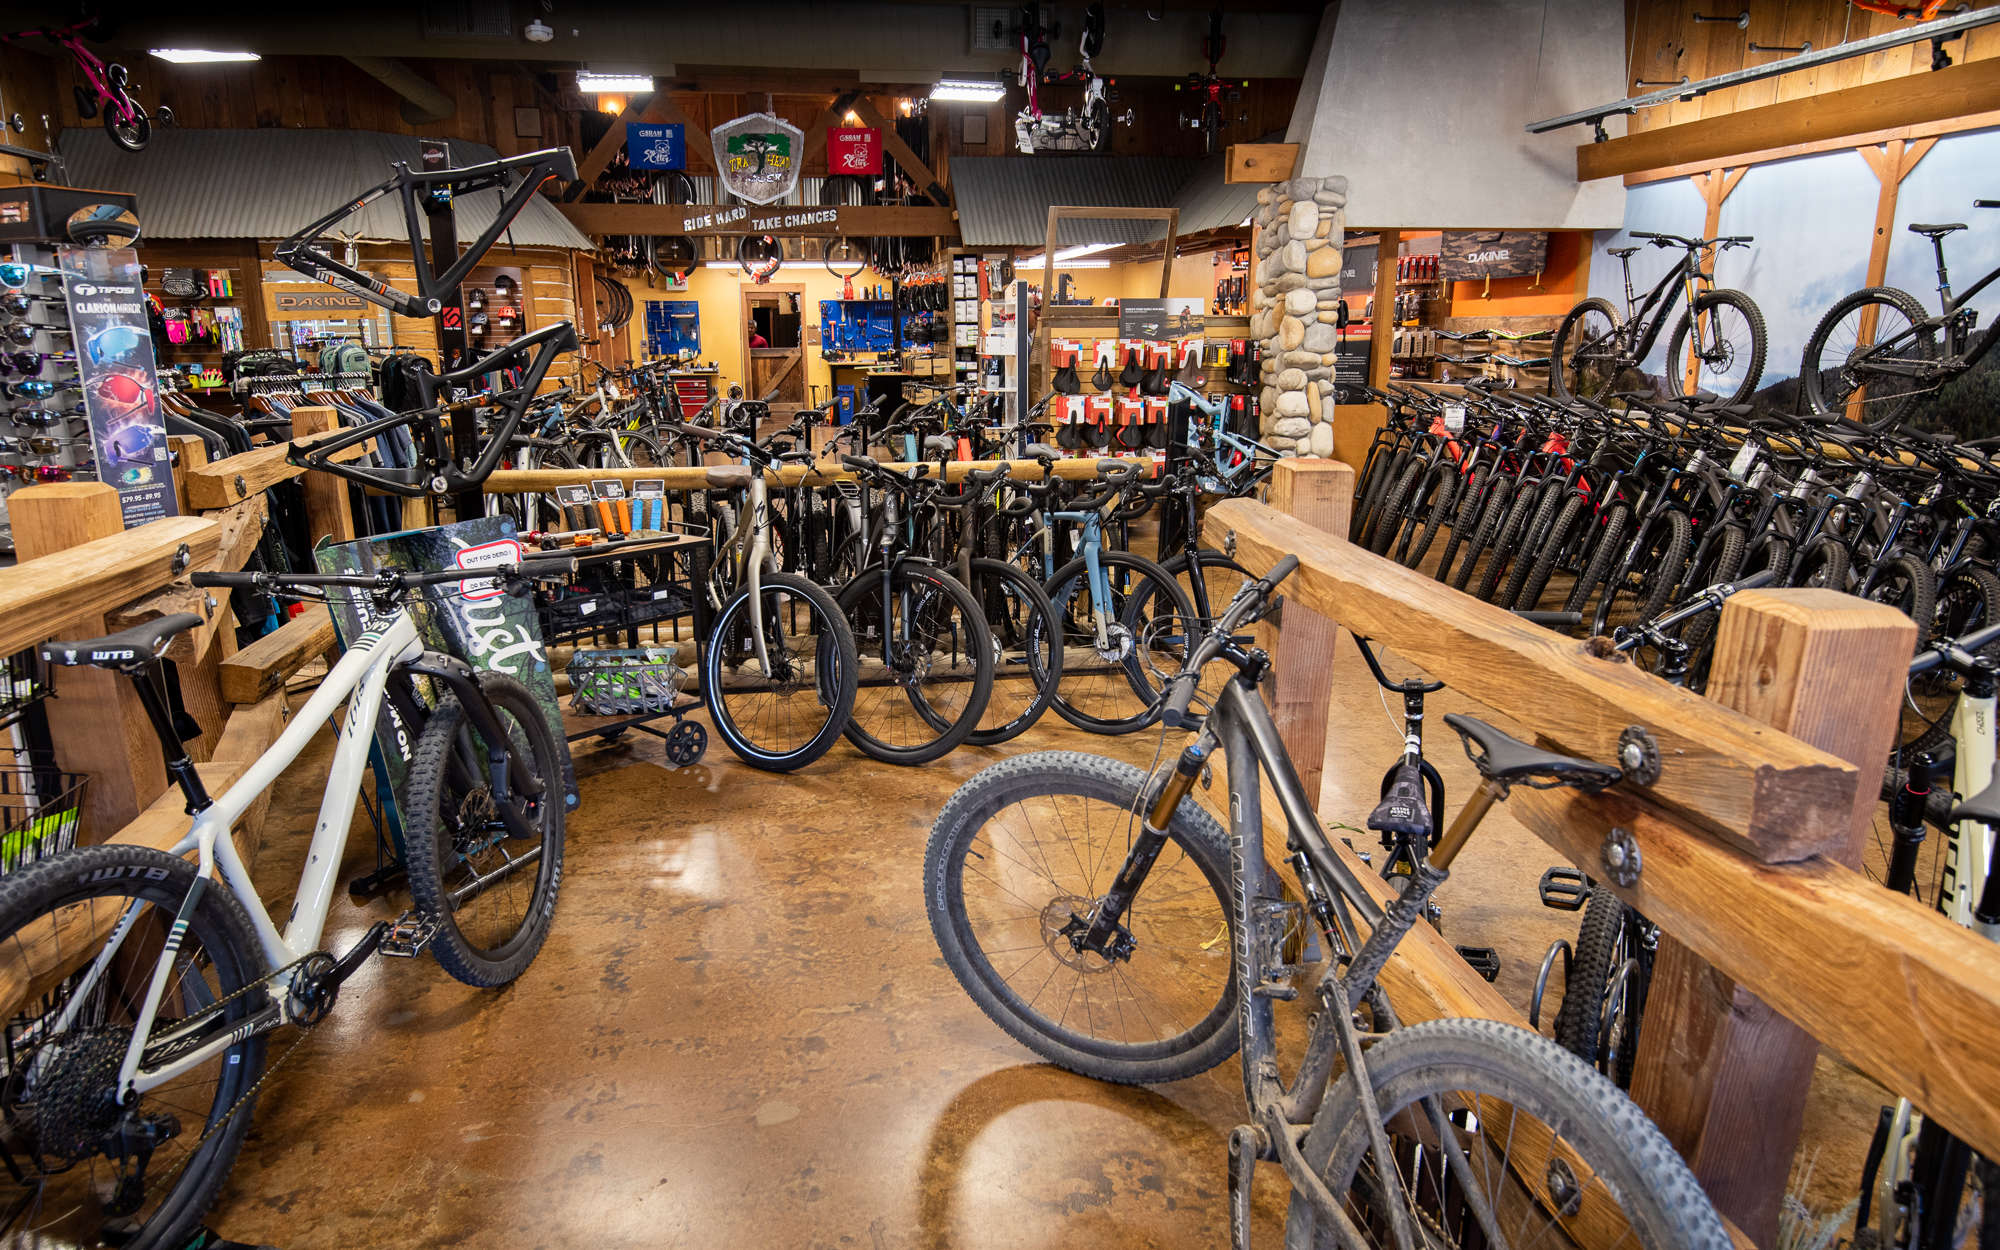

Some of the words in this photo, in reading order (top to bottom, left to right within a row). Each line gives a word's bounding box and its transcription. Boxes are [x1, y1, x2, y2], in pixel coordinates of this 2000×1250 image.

[684, 214, 712, 232] RIDE
[715, 207, 747, 225] HARD
[752, 216, 782, 231] TAKE
[784, 209, 838, 228] CHANCES
[1467, 250, 1510, 264] DAKINE
[97, 286, 135, 294] TIFOSI
[280, 296, 363, 307] DAKINE
[121, 494, 142, 504] $79.95
[492, 550, 508, 559] DEMO
[92, 650, 134, 660] WTB
[91, 865, 170, 881] WTB
[937, 858, 947, 911] GROUND
